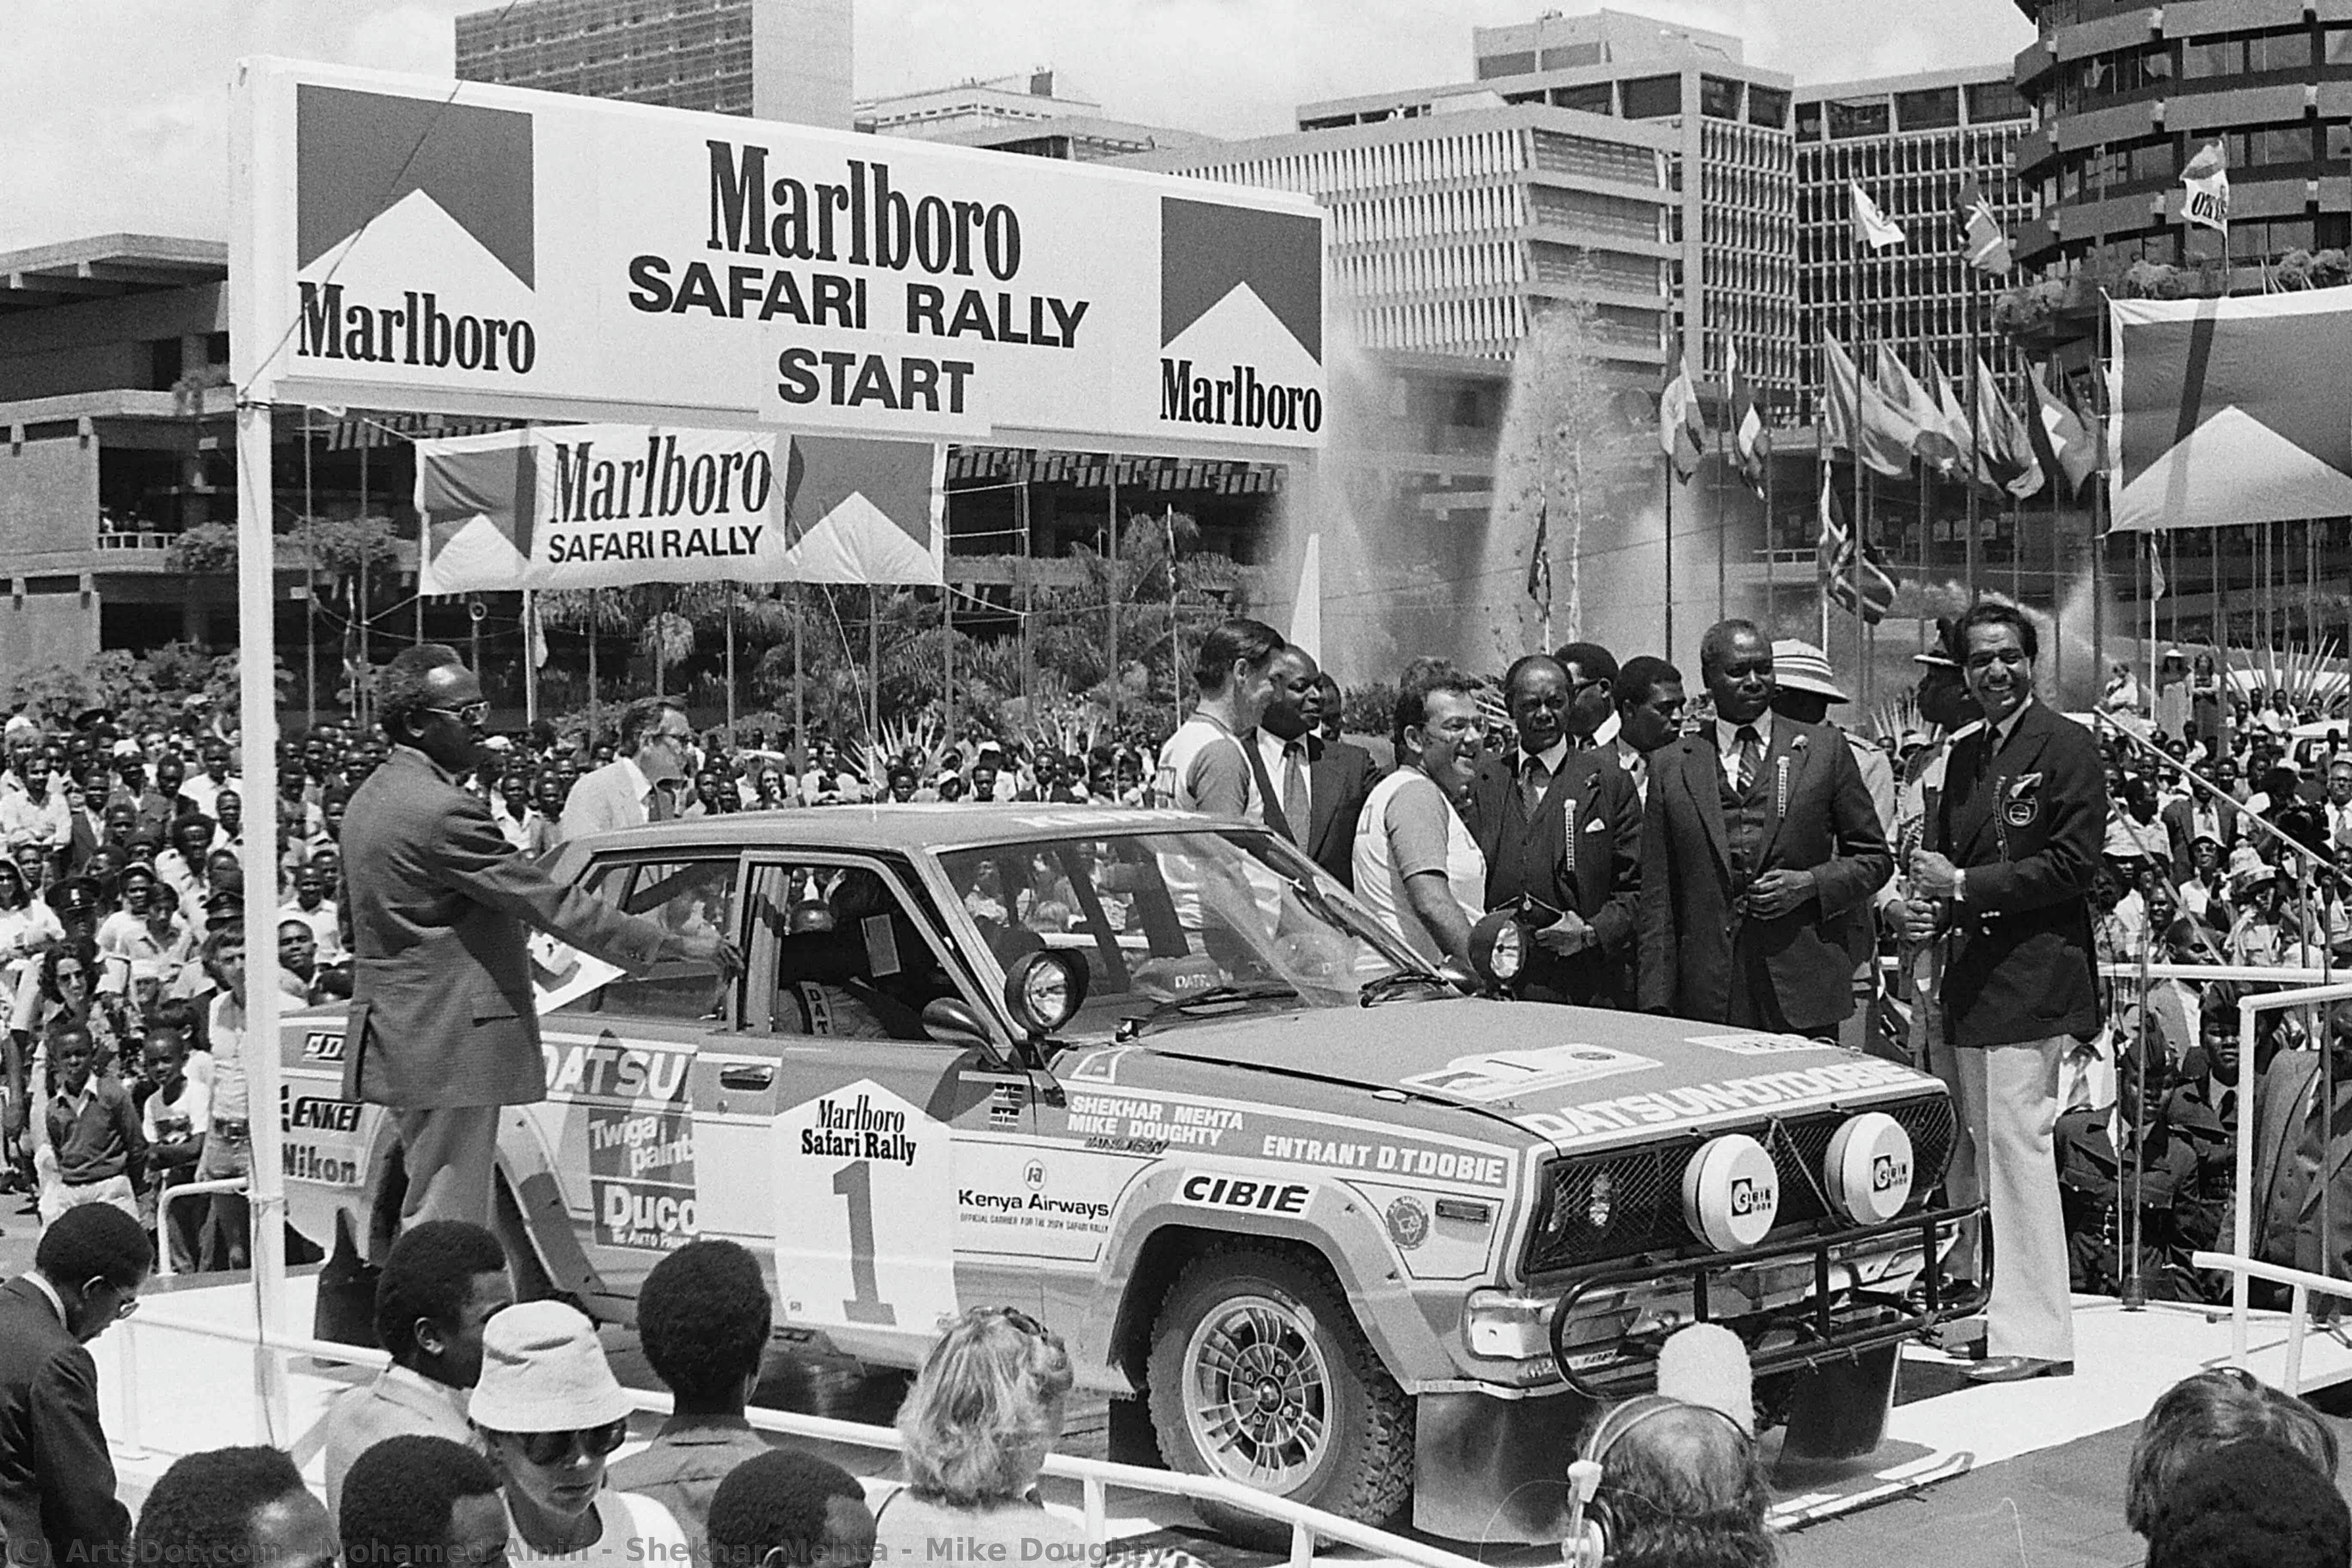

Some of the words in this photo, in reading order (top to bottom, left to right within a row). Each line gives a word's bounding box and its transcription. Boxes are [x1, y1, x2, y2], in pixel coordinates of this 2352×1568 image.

[707, 140, 1021, 281] Marlboro
[628, 255, 867, 329] SAFARI
[906, 282, 1090, 349] RALLY
[297, 281, 536, 374] Marlboro
[778, 348, 974, 414] START
[1160, 358, 1322, 432] Marlboro
[549, 434, 771, 524] Marlboro
[548, 528, 654, 563] SAFARI
[662, 525, 764, 558] RALLY
[542, 1044, 693, 1100] DATSU
[292, 1096, 363, 1132] ENKEI
[590, 1112, 657, 1149] Twiga
[817, 1094, 905, 1133] Marlboro
[1067, 1113, 1119, 1135] MIKE
[1130, 1120, 1223, 1146] DOUGHTY
[1071, 1095, 1163, 1120] SHEKHAR
[1174, 1105, 1243, 1130] MEHTA
[281, 1143, 356, 1183] Nikon
[801, 1129, 861, 1157] Safari
[865, 1132, 917, 1166] Rally
[1262, 1135, 1372, 1167] ENTRANT
[603, 1184, 698, 1235] Duco
[958, 1189, 1022, 1212] Kenya
[1028, 1194, 1109, 1220] Airways
[833, 1160, 897, 1326] 1
